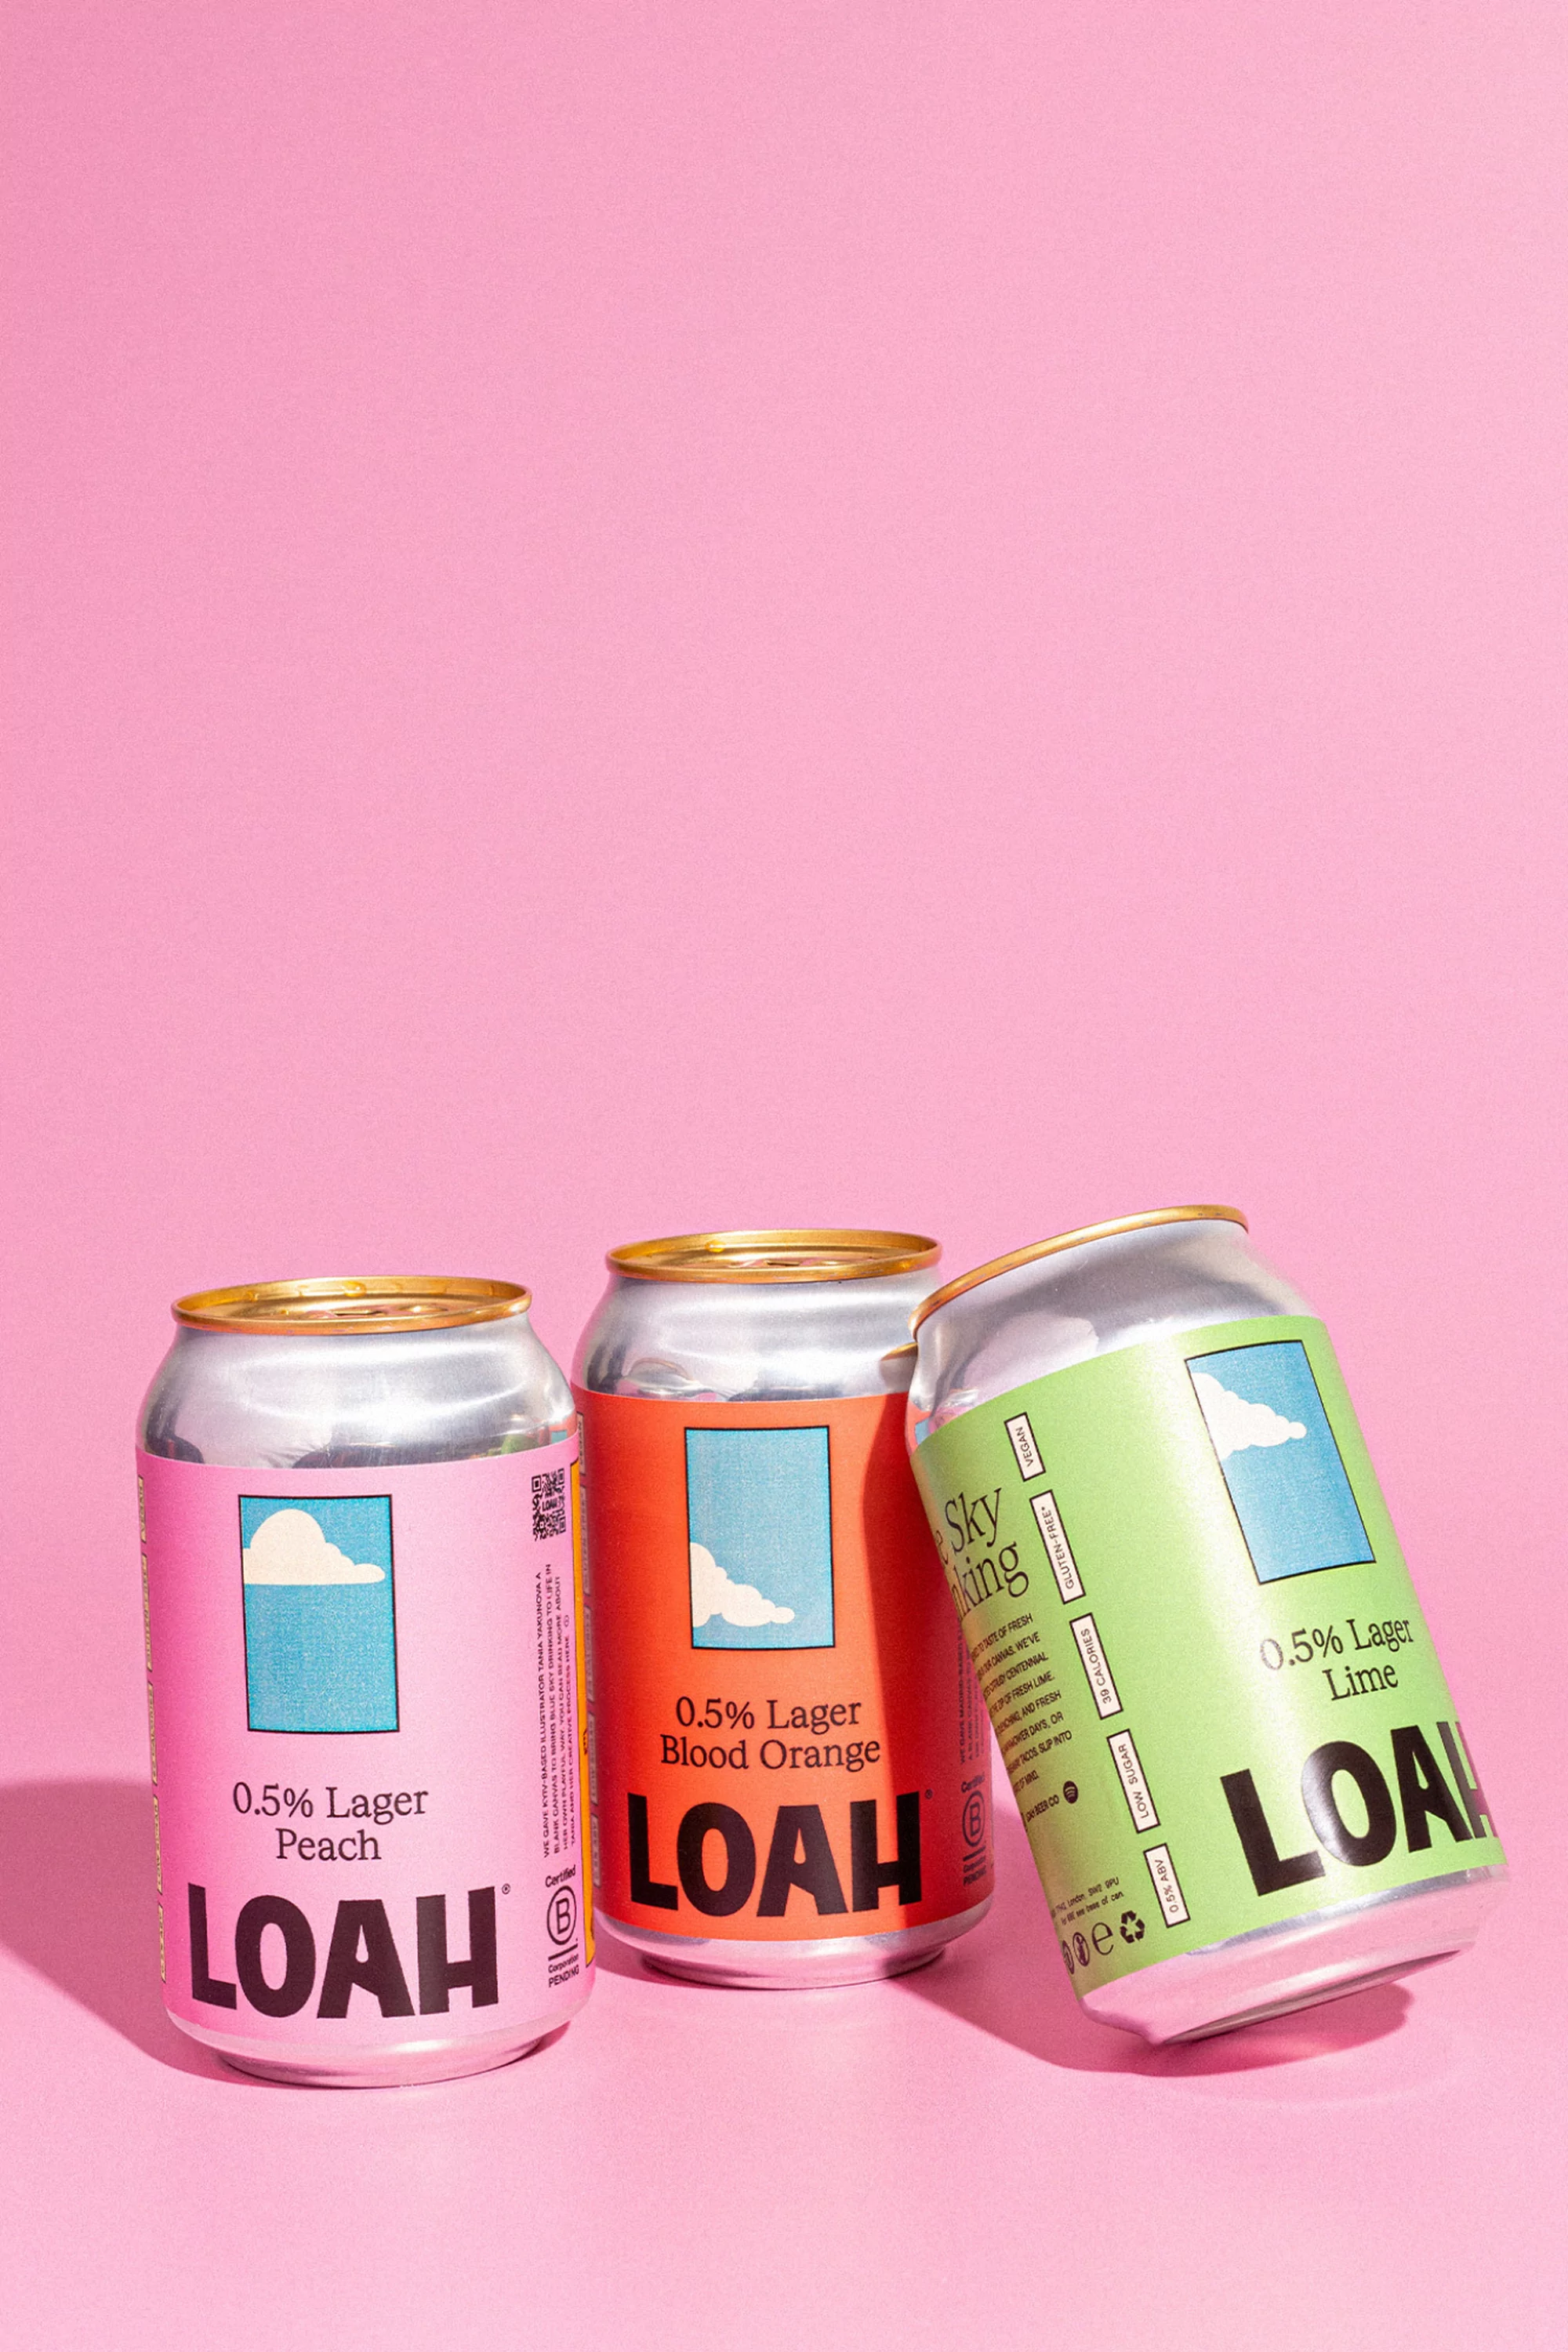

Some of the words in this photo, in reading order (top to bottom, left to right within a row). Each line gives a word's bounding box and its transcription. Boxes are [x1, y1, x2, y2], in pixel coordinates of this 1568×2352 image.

[1017, 1427, 1033, 1467] VEGAN
[945, 1487, 1002, 1555] Sky
[545, 1563, 551, 1575] IN
[546, 1602, 552, 1616] TO
[999, 1626, 1008, 1639] OF
[1008, 1613, 1033, 1633] FRESH
[1015, 1632, 1041, 1651] WE'VE
[1259, 1625, 1345, 1671] 0.5%
[1345, 1617, 1414, 1653] Lager
[1005, 1652, 1049, 1680] CENTENNIAL
[1080, 1628, 1106, 1686] CALORIES
[1011, 1682, 1033, 1700] FRESH
[1322, 1664, 1399, 1701] Lime
[1021, 1703, 1036, 1717] AND
[1035, 1690, 1062, 1709] FRESH
[1100, 1689, 1112, 1704] 39
[676, 1697, 754, 1730] 0.5%
[768, 1699, 862, 1736] Lager
[1051, 1711, 1065, 1725] OR
[661, 1734, 750, 1769] Blood
[760, 1740, 881, 1773] Orange
[1038, 1739, 1054, 1754] SLIP
[1054, 1730, 1073, 1746] INTO
[551, 1759, 557, 1772] TO
[1118, 1743, 1138, 1785] SUGAR
[233, 1781, 314, 1817] 0.5%
[327, 1786, 428, 1825] Lager
[1048, 1794, 1059, 1808] CO
[1133, 1791, 1149, 1819] LOW
[1220, 1720, 1498, 1897] LOAH
[275, 1828, 383, 1861] Peach
[543, 1839, 550, 1858] WE
[627, 1791, 923, 1918] LOAH
[545, 1864, 576, 1889] Certified
[1154, 1859, 1169, 1882] ABV
[1101, 1895, 1109, 1905] of
[1163, 1884, 1179, 1913] 0.5%
[187, 1882, 500, 2019] LOAH
[548, 1954, 579, 1973] Corporation
[548, 1965, 580, 1987] PENDING
